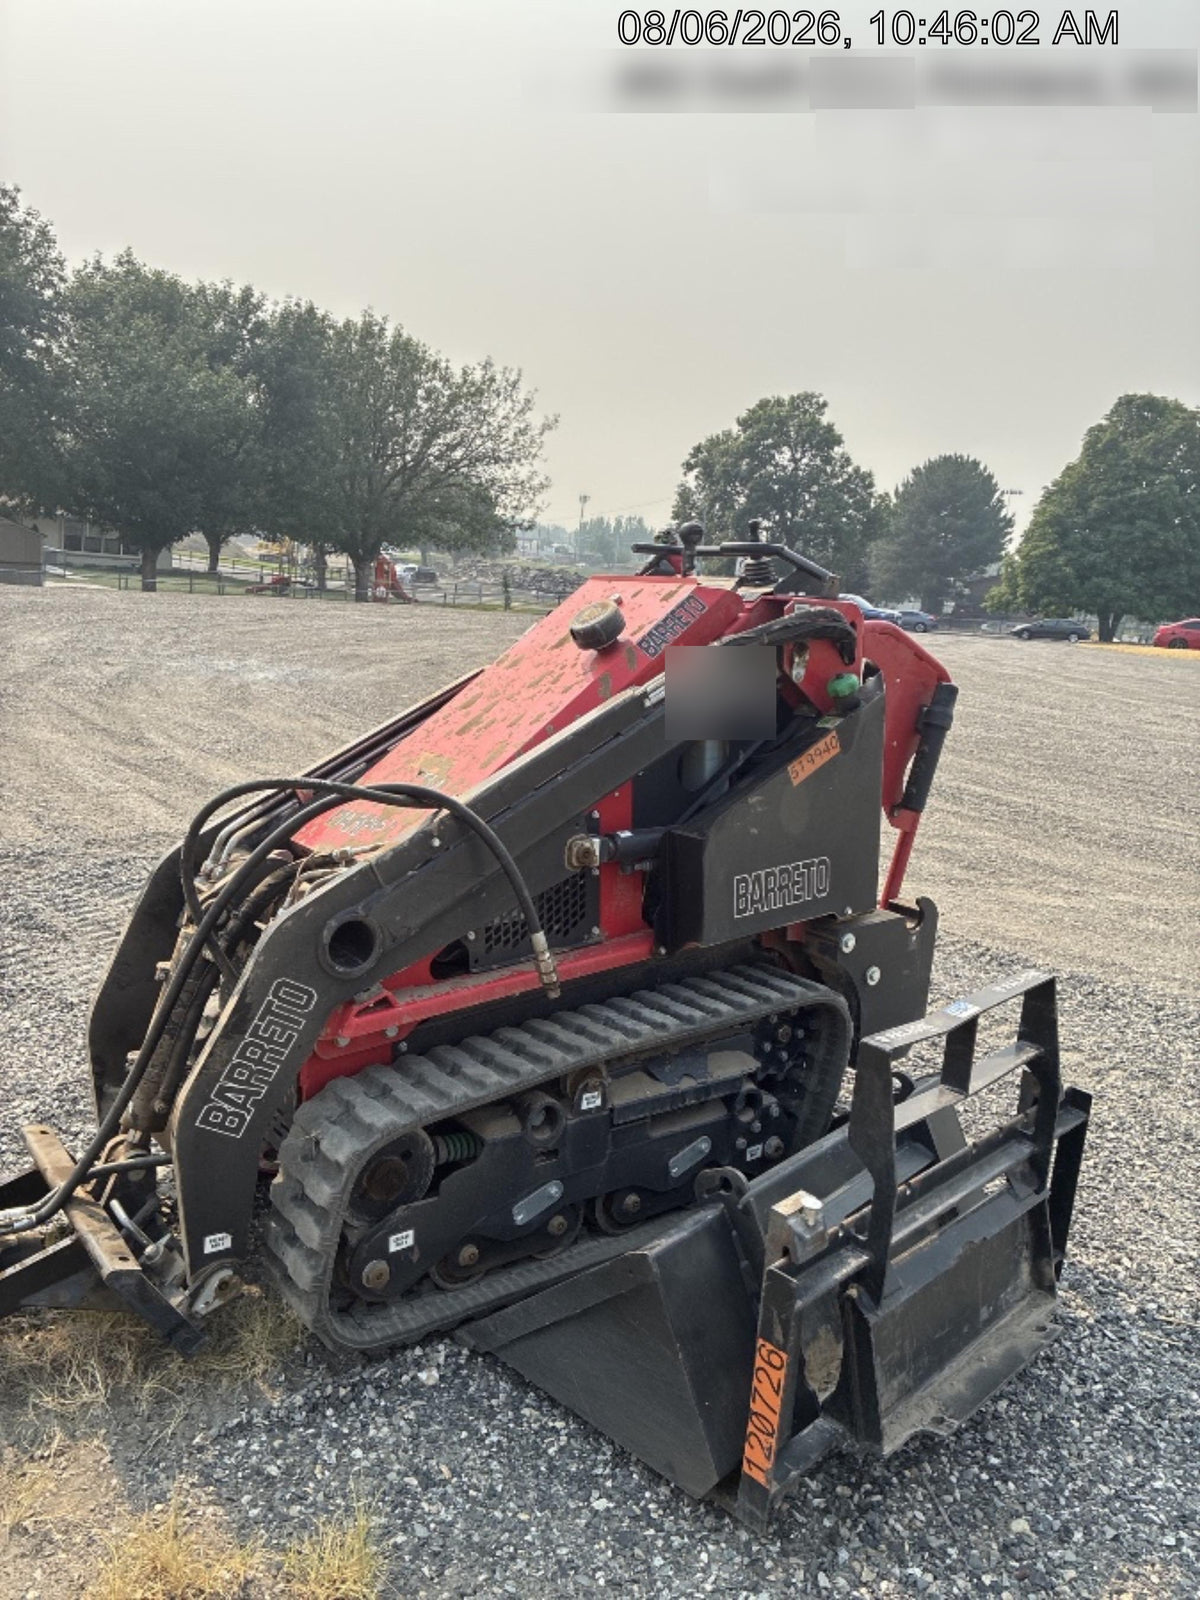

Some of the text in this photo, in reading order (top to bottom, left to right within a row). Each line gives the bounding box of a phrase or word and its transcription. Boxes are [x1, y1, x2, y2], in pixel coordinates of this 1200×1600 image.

[636, 593, 709, 660] BARRETO
[733, 856, 831, 919] BARRETO
[195, 977, 318, 1139] BARRETO
[744, 1343, 785, 1473] 120726
